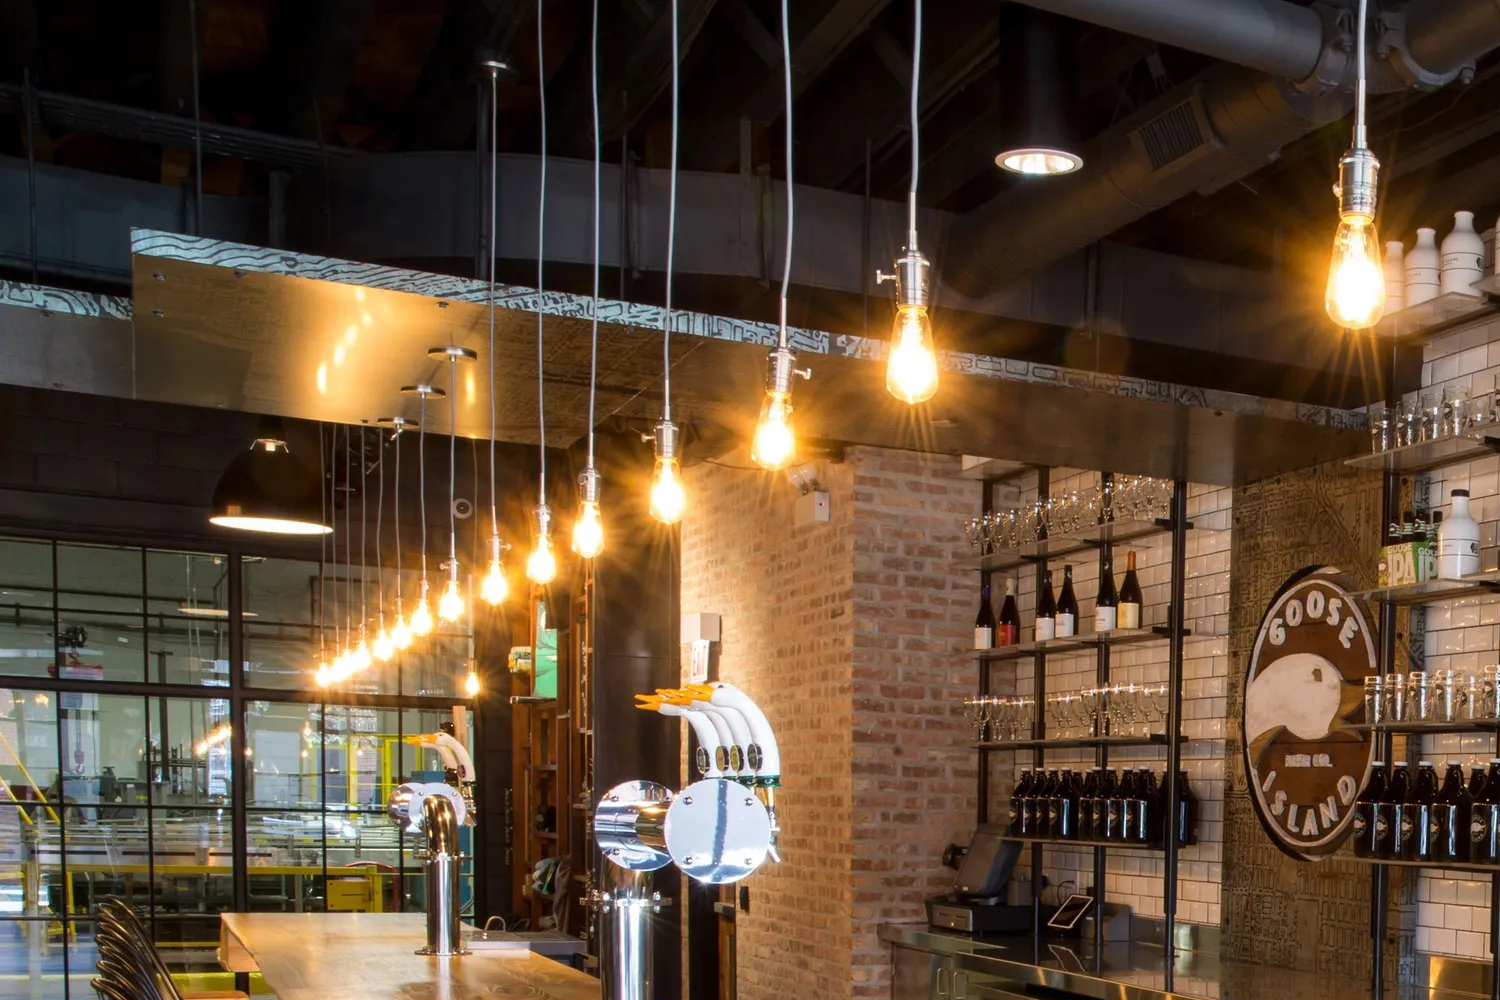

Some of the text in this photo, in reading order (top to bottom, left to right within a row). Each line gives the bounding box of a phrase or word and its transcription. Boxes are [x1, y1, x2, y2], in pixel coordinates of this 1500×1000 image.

[1387, 542, 1413, 554] GOOSE
[1387, 551, 1417, 587] IPA
[1269, 590, 1359, 649] GOOSE
[1262, 774, 1357, 836] ISLAND
